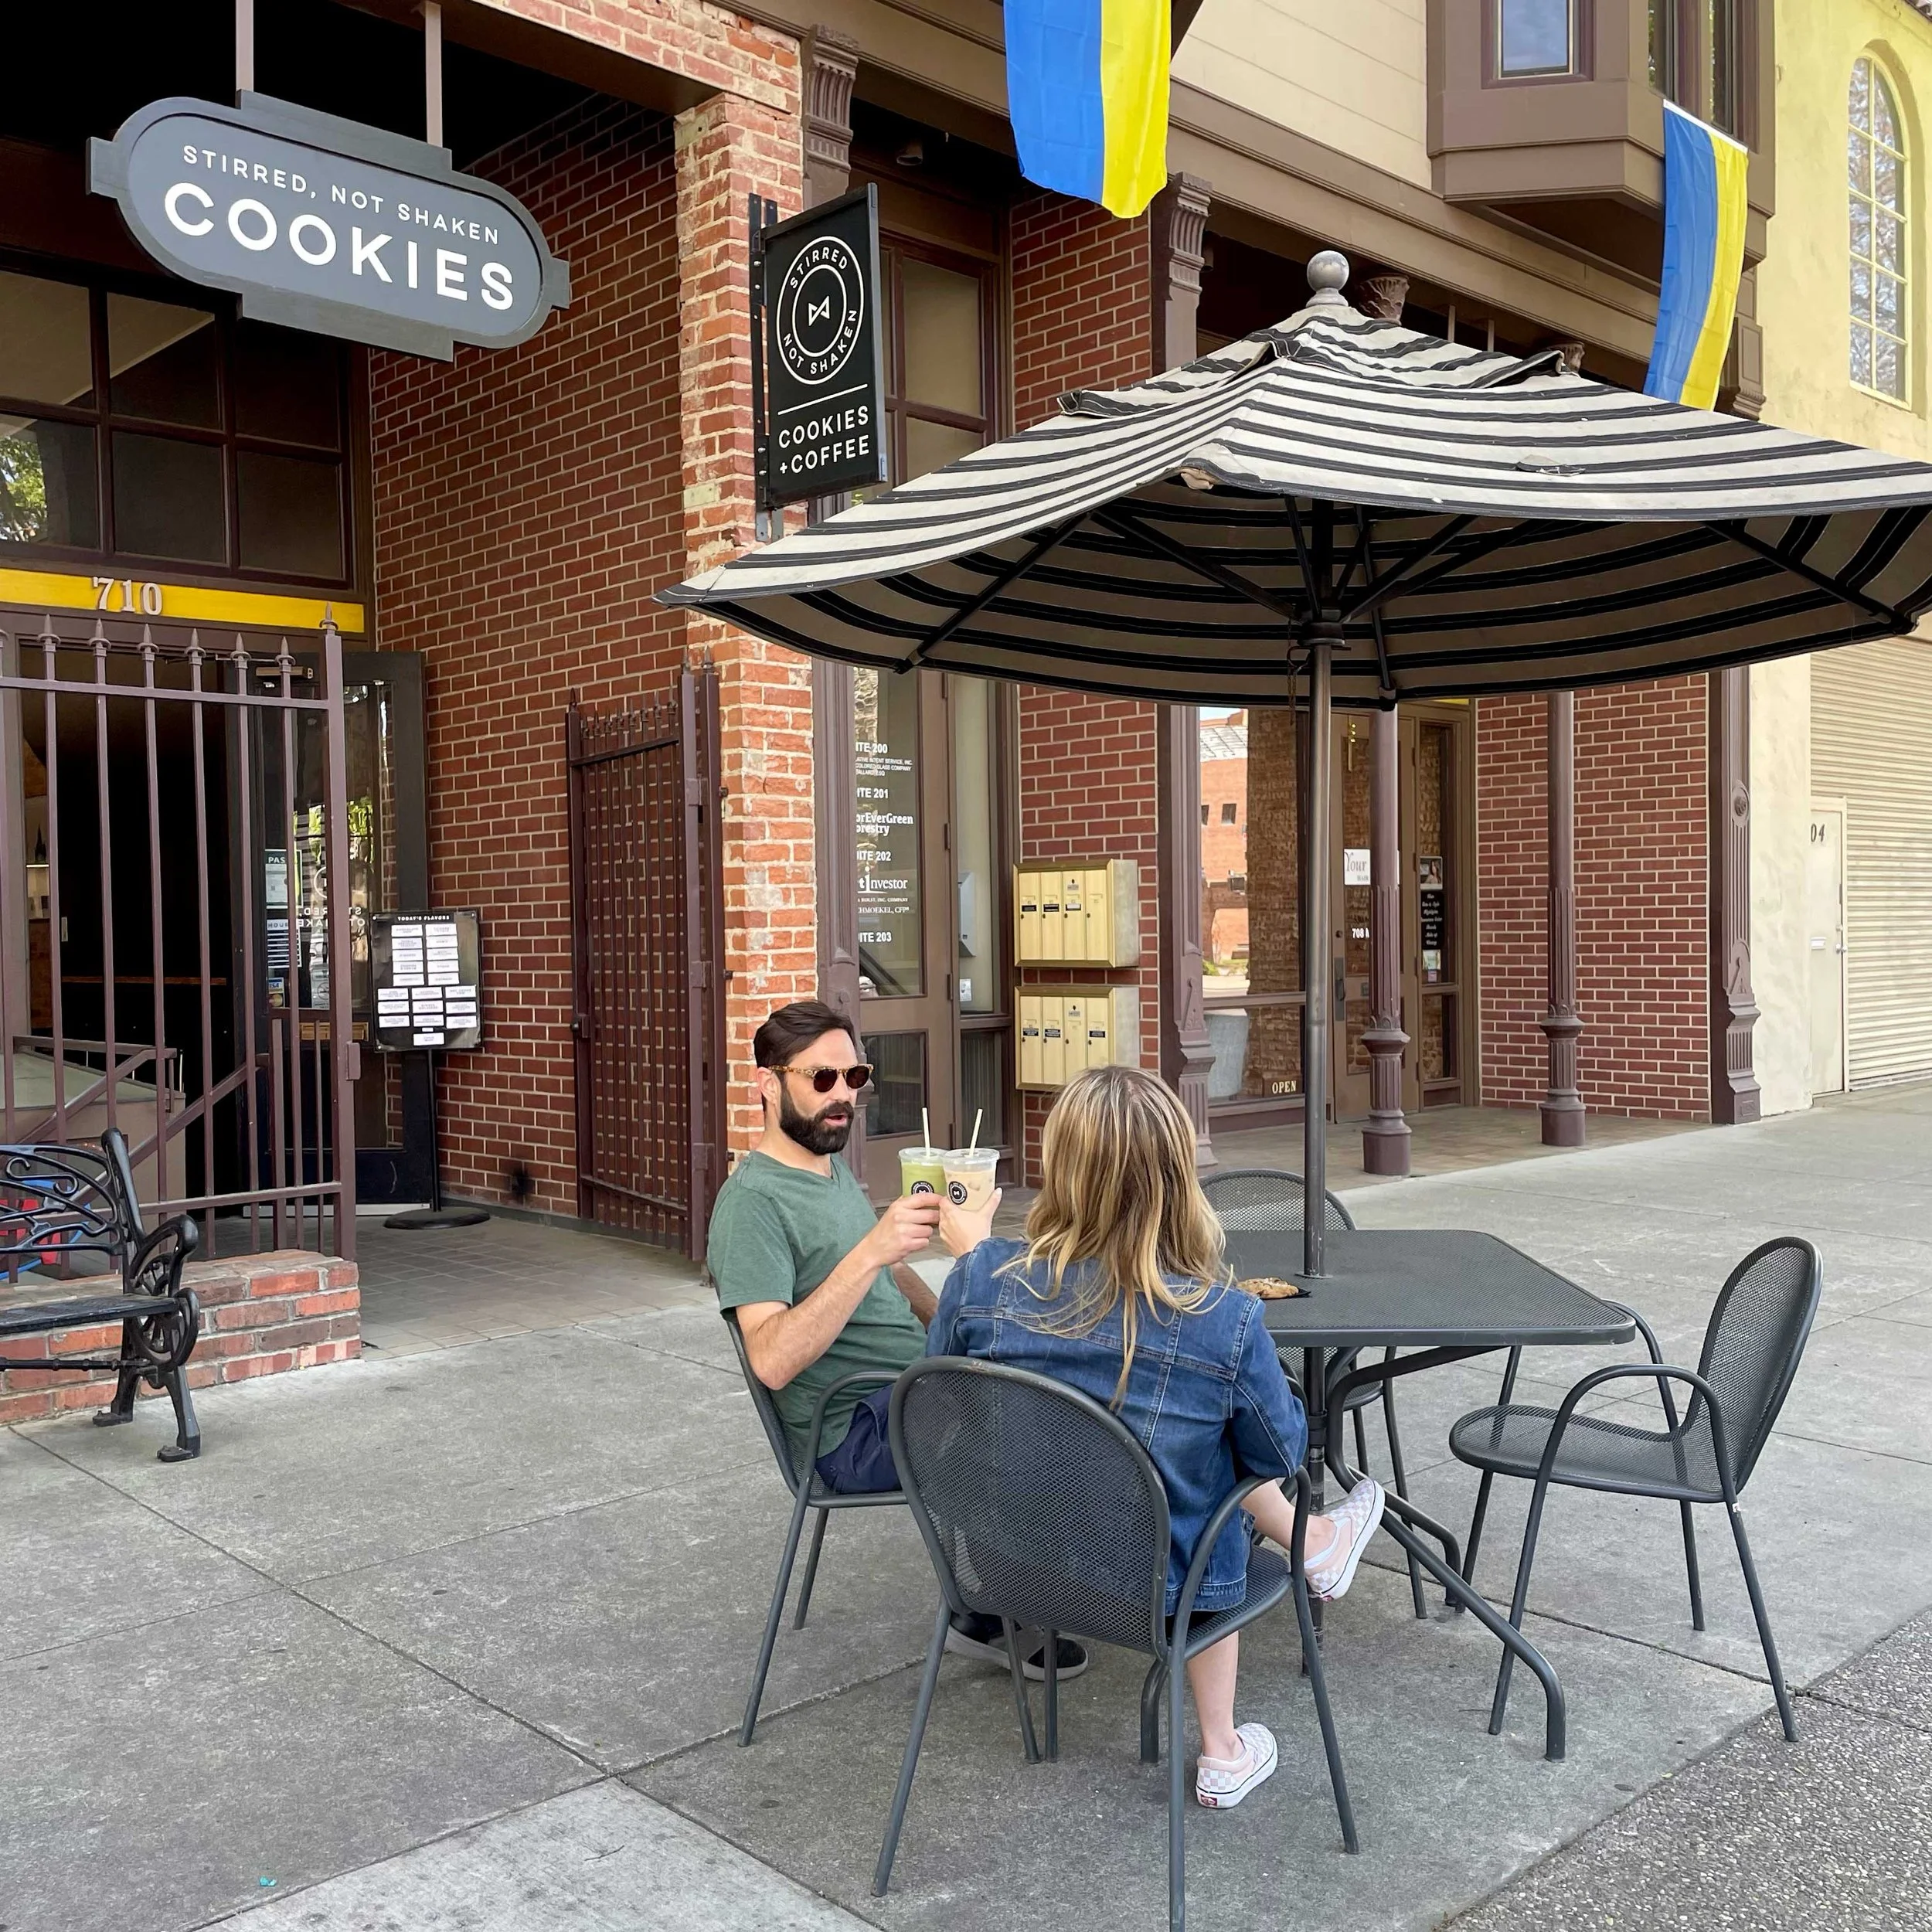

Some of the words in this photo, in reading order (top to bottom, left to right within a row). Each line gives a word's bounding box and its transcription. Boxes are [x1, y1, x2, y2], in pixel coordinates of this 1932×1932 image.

[183, 145, 317, 199] STIRRED,
[332, 185, 384, 213] NOT
[397, 203, 499, 245] SHAKEN
[164, 182, 514, 311] COOKIES
[790, 247, 848, 289] STIRRED
[783, 333, 804, 369] NOT
[809, 310, 857, 375] SHAKEN
[778, 405, 869, 449] COOKIES
[779, 435, 869, 474] +COFFEE
[93, 577, 162, 615] 710
[855, 742, 870, 753] ITE
[872, 743, 889, 754] 200
[856, 787, 872, 798] ITE
[873, 788, 889, 798] 201
[856, 812, 913, 825] orEverGreen
[856, 824, 889, 836] orestry
[1811, 823, 1825, 842] 04
[856, 851, 873, 861] ITE
[876, 851, 891, 862] 202
[1344, 852, 1367, 872] Your
[859, 932, 874, 942] ITE
[876, 931, 892, 942] 203
[1271, 1080, 1297, 1094] OPEN
